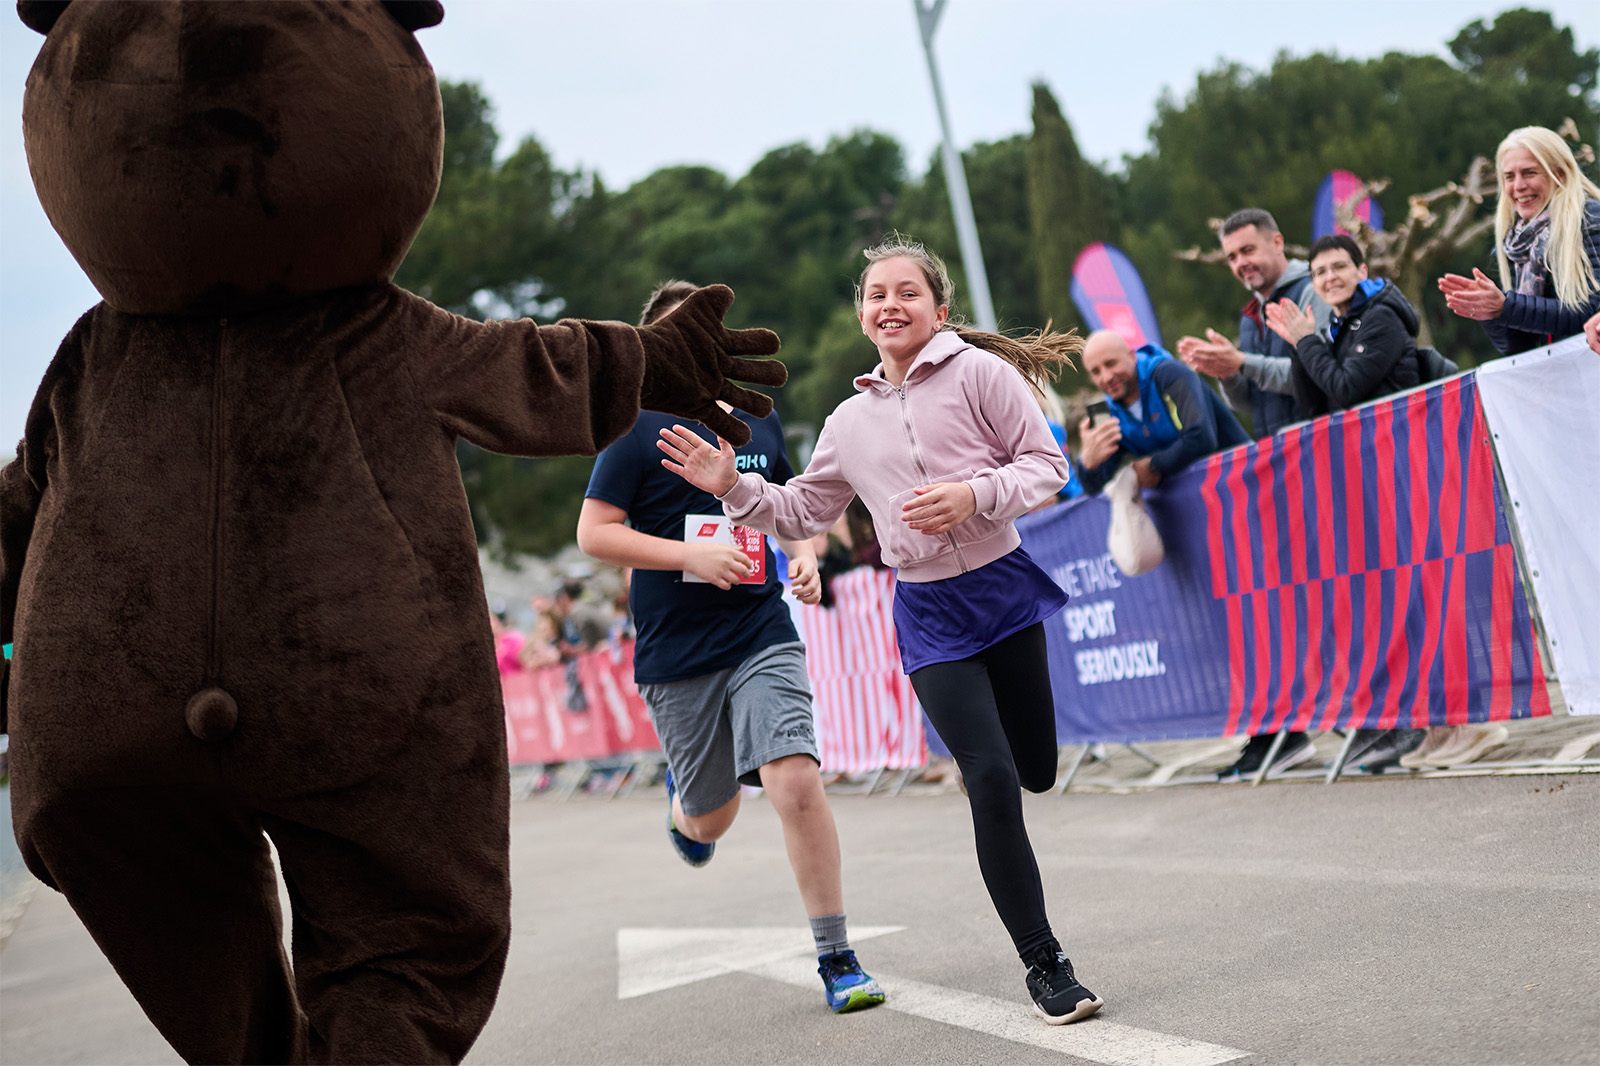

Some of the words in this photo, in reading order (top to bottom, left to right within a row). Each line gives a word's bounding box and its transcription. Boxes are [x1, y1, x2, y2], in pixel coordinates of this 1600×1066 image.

[735, 454, 768, 469] AKO
[746, 537, 760, 545] KIDS
[1077, 552, 1122, 595] TAKE
[1063, 599, 1117, 643] SPORT
[1074, 639, 1167, 686] SERIOUSLY.
